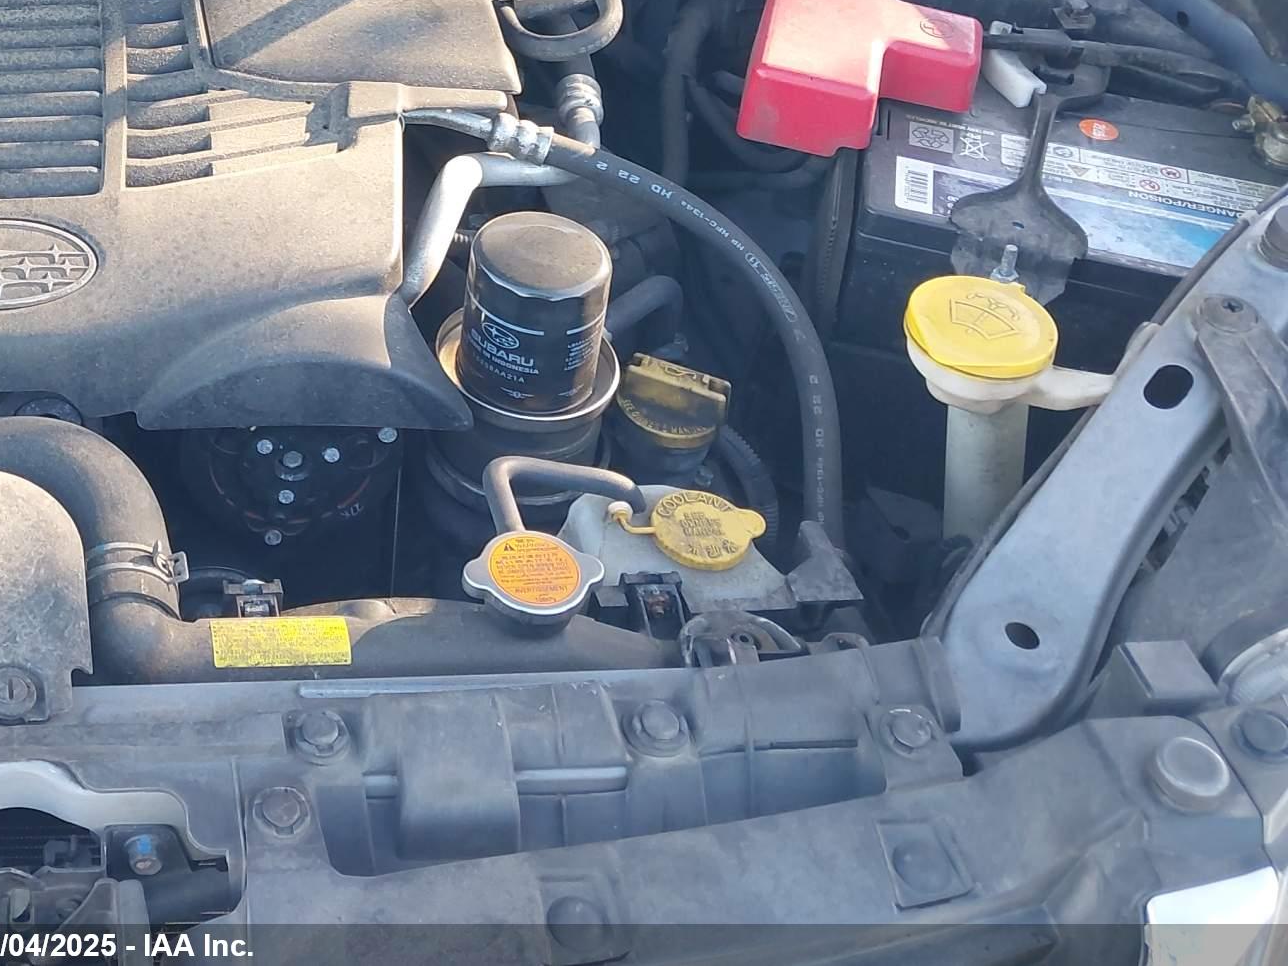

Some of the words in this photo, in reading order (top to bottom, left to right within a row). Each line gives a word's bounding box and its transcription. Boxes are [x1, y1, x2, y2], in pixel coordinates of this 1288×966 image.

[595, 160, 609, 171] 2
[617, 169, 641, 184] 22
[650, 183, 673, 199] HD
[680, 199, 729, 238] HFC-134a
[730, 237, 745, 251] HP
[1128, 190, 1244, 219] DANGER/POISON
[471, 327, 534, 367] SUBARU
[492, 355, 540, 375] INDONESIA
[809, 374, 819, 385] 2
[812, 393, 823, 415] 22
[815, 427, 825, 448] HD
[656, 491, 732, 518] COOLANT
